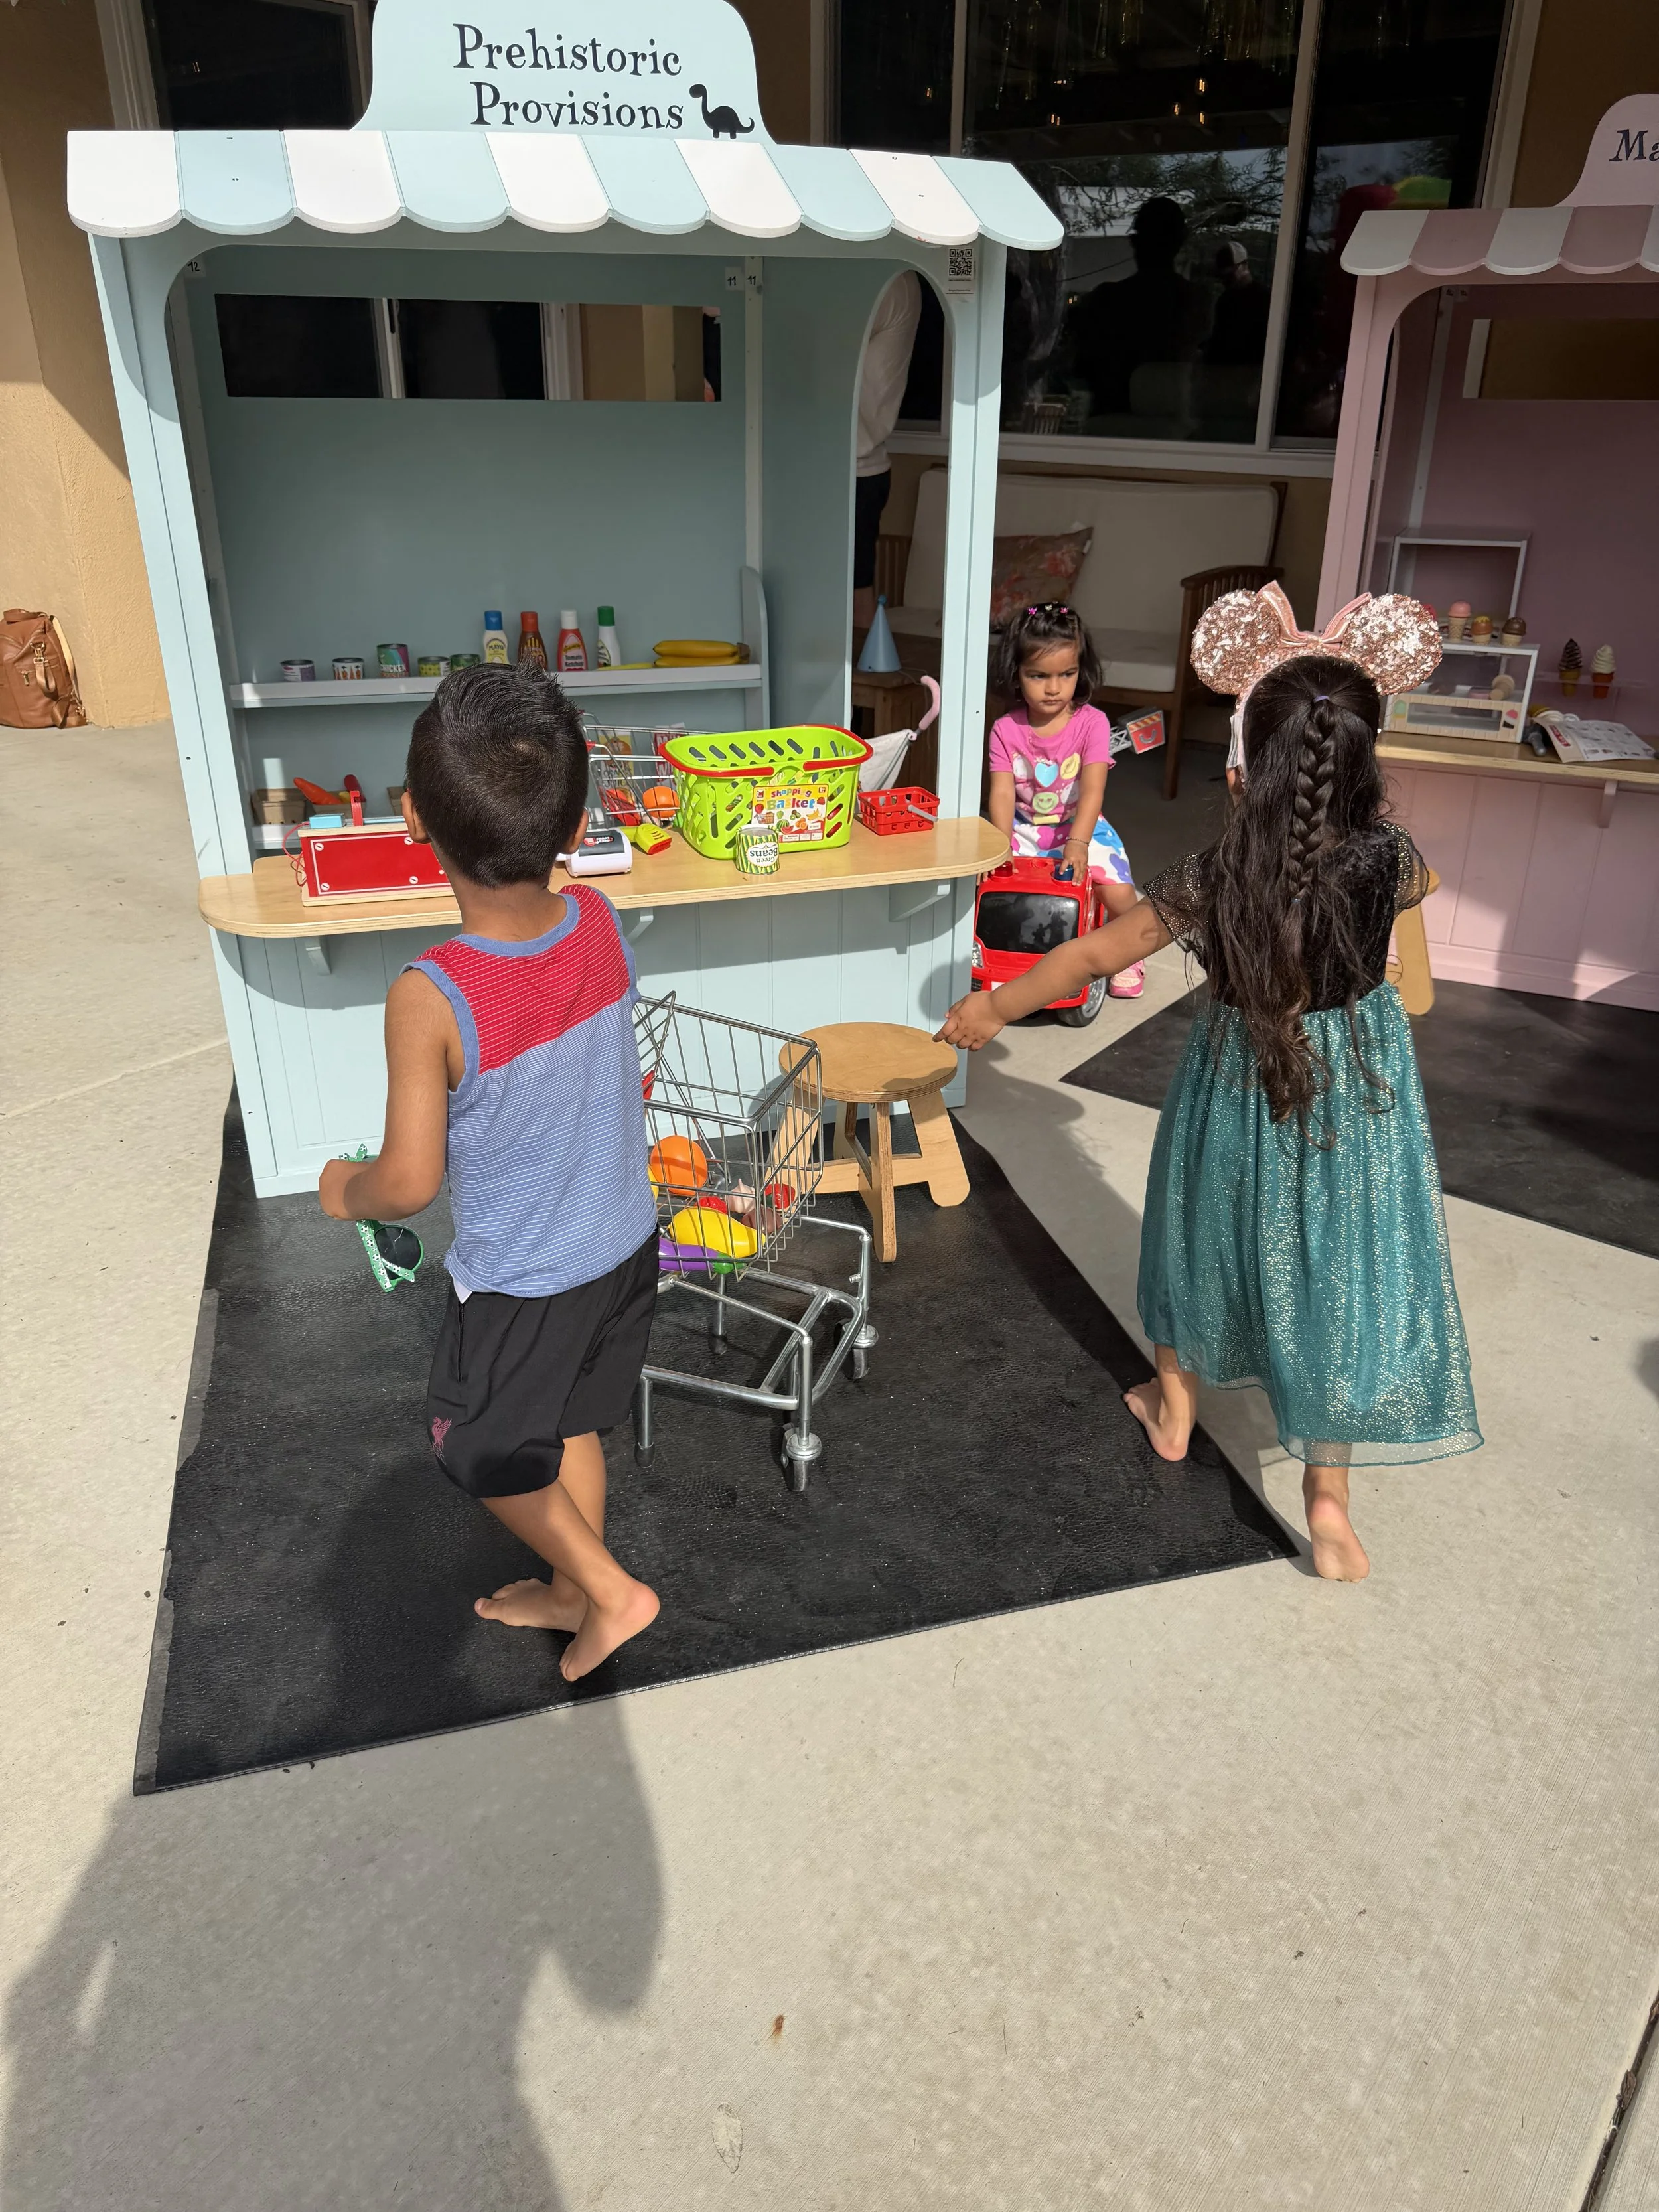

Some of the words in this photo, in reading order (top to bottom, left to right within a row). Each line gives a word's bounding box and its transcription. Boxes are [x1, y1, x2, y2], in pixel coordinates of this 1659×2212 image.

[453, 23, 682, 76] Prehistoric
[470, 81, 684, 129] Provisions
[1609, 129, 1659, 161] Ma
[187, 261, 200, 272] 12
[770, 788, 812, 798] Shoppig
[766, 798, 816, 810] Basket
[749, 847, 778, 857] Beans
